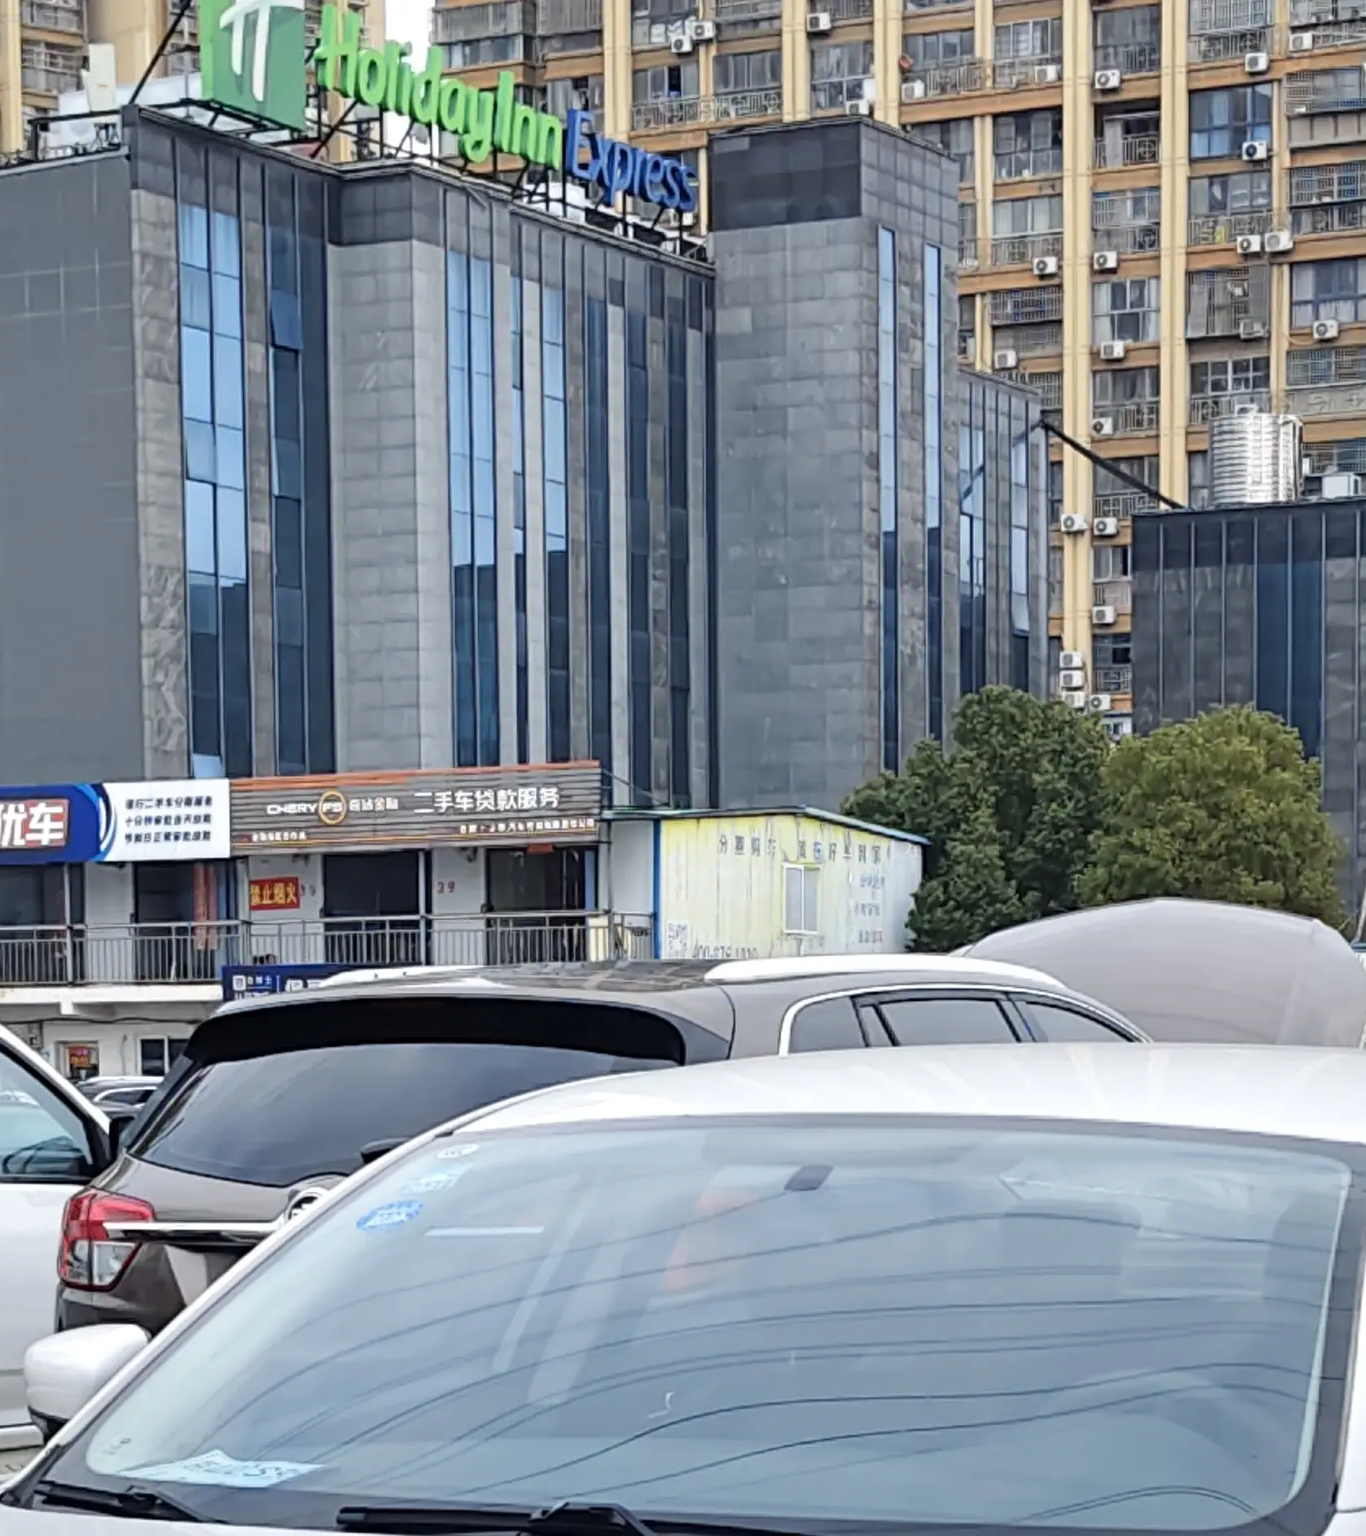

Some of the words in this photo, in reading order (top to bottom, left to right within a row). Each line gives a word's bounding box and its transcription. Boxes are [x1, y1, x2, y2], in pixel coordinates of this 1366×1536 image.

[315, 3, 494, 163] Holiday
[494, 71, 562, 170] Inn
[566, 108, 697, 213] Express
[266, 803, 317, 815] CHERY
[413, 787, 560, 814] 二手车贷款服务
[250, 882, 297, 906] 禁止烟火
